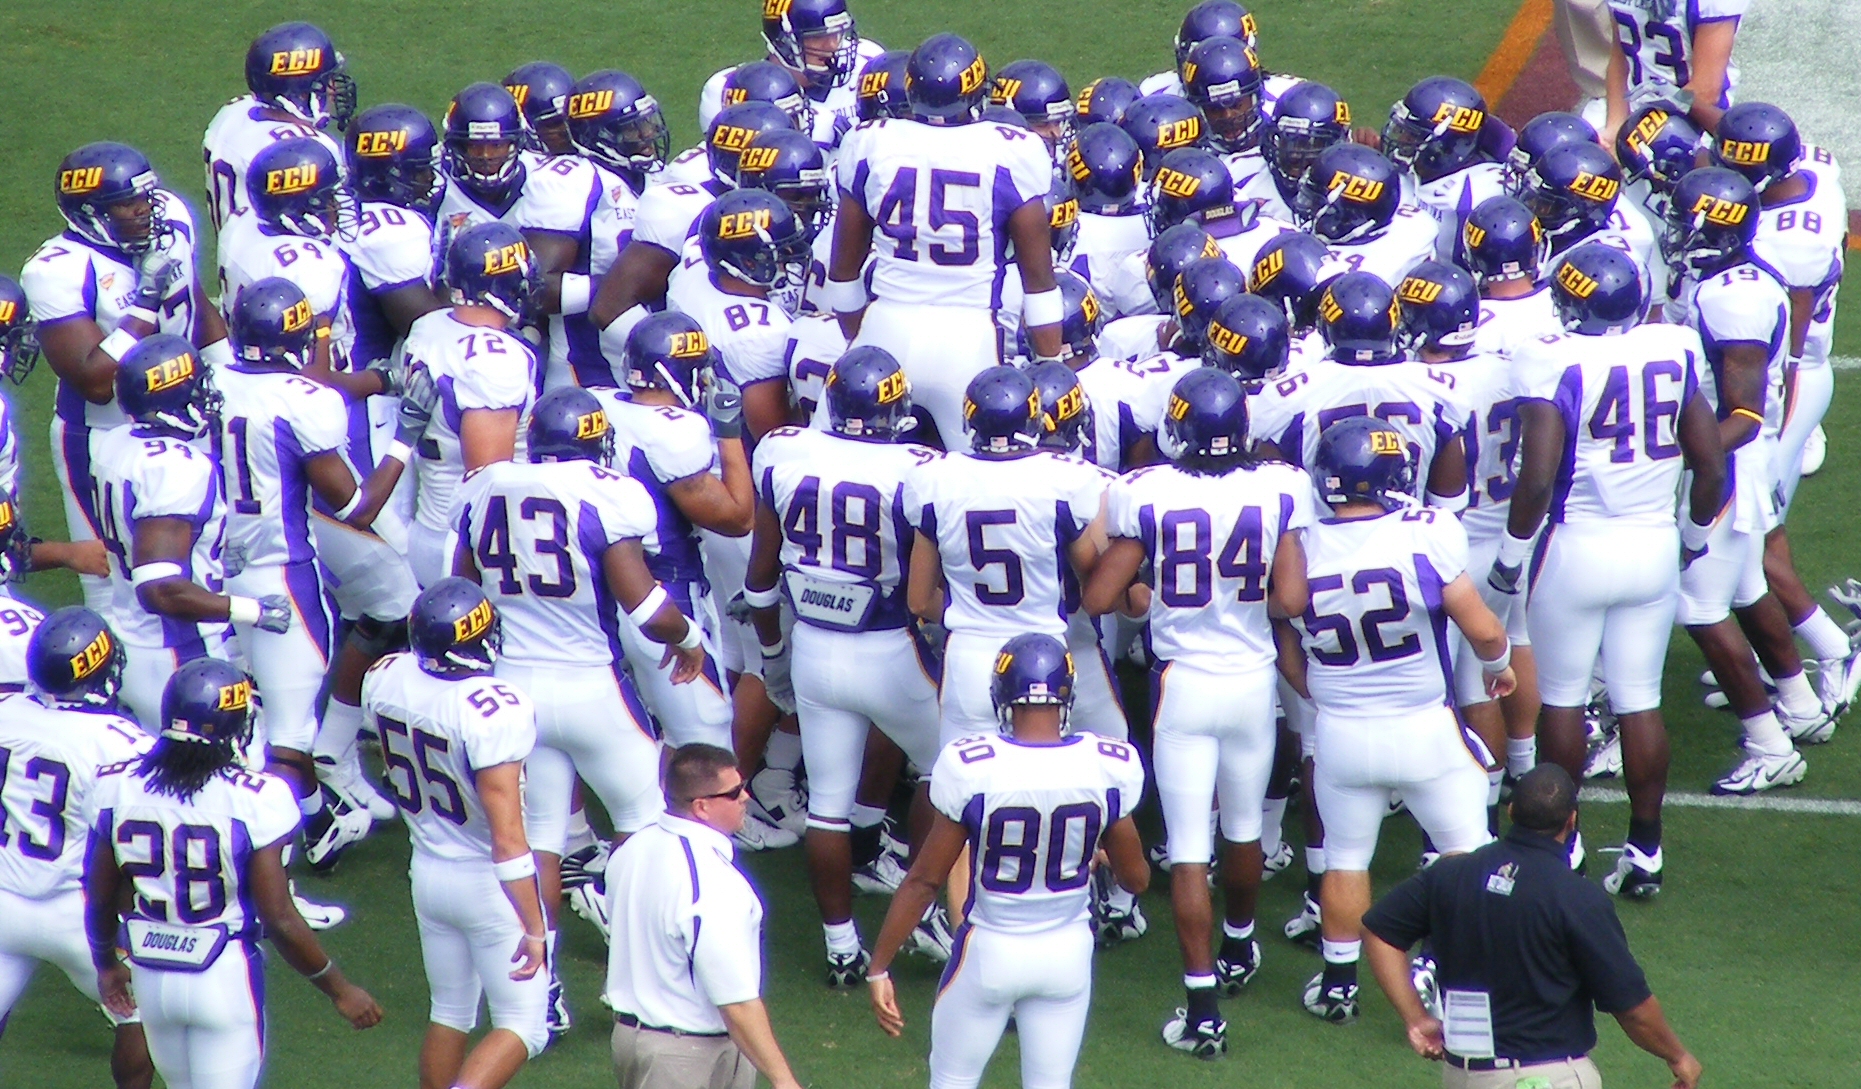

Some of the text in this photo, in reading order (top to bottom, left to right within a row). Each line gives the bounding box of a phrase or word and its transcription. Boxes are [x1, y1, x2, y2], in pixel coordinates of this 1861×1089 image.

[271, 48, 323, 76] ECU
[858, 71, 889, 99] CU
[991, 77, 1021, 104] CU
[569, 90, 613, 119] ECU
[1433, 102, 1484, 133] ECU
[356, 129, 408, 157] ECU
[1157, 117, 1200, 149] ECU
[1626, 109, 1670, 154] ECU
[740, 147, 781, 172] ECU
[1722, 140, 1771, 166] ECU
[60, 166, 104, 194] ECU
[266, 163, 319, 195] ECU
[1156, 167, 1202, 198] ECU
[1329, 170, 1385, 203] ECU
[1570, 172, 1621, 201] ECU
[358, 208, 406, 237] 90
[718, 208, 771, 241] ECU
[876, 166, 981, 267] 45
[1205, 205, 1235, 221] DOUGLAS
[1693, 194, 1750, 226] ECU
[1777, 210, 1822, 233] 88
[1464, 219, 1486, 249] CU
[484, 241, 528, 275] ECU
[1400, 276, 1443, 305] ECU
[1558, 262, 1600, 299] ECU
[1721, 268, 1760, 287] 19
[724, 304, 772, 332] 87
[457, 332, 507, 361] 72
[1207, 319, 1249, 356] ECU
[145, 353, 194, 394] ECU
[877, 370, 907, 406] EC
[1057, 383, 1086, 421] EC
[1589, 360, 1684, 462] 46
[1370, 430, 1404, 455] EC
[785, 475, 882, 580] 48
[477, 495, 578, 600] 43
[966, 509, 1025, 607] 5
[1160, 505, 1267, 609] 84
[800, 588, 854, 614] DOUGLAS
[1301, 567, 1424, 667] 52
[453, 598, 494, 646] ECU
[70, 630, 111, 682] ECU
[467, 684, 520, 717] 55
[375, 712, 468, 827] 55
[981, 801, 1101, 894] 80
[117, 819, 226, 924] 28
[142, 931, 198, 954] DOUGLAS
